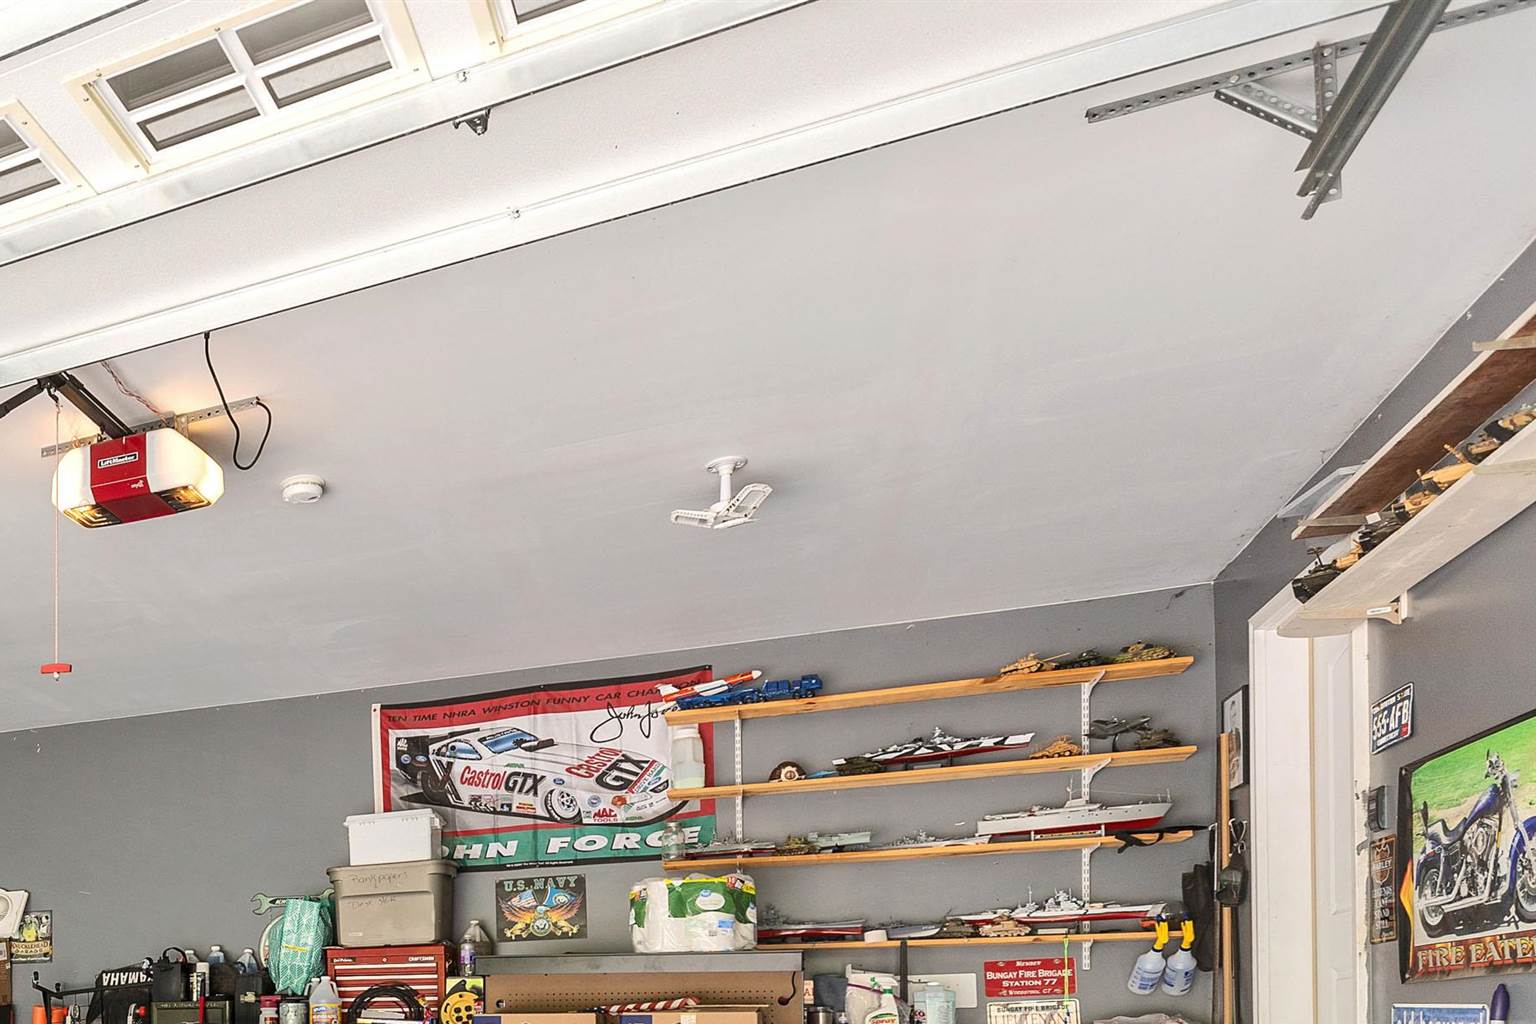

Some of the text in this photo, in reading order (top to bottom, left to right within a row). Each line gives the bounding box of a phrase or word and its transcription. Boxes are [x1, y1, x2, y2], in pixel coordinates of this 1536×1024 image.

[387, 715, 408, 723] TEN
[413, 713, 438, 722] TIME
[442, 709, 477, 720] NHRA
[482, 699, 541, 715] WINSTON
[546, 695, 590, 705] FUNNY
[595, 692, 622, 701] CAR
[565, 747, 622, 779] Castrol
[595, 753, 650, 792] GTX
[460, 766, 546, 797] Castrol GTX
[534, 876, 577, 890] NAVY
[1417, 946, 1464, 971] FIRE
[986, 970, 1018, 980] BUNGAY
[1018, 969, 1037, 979] FIRE
